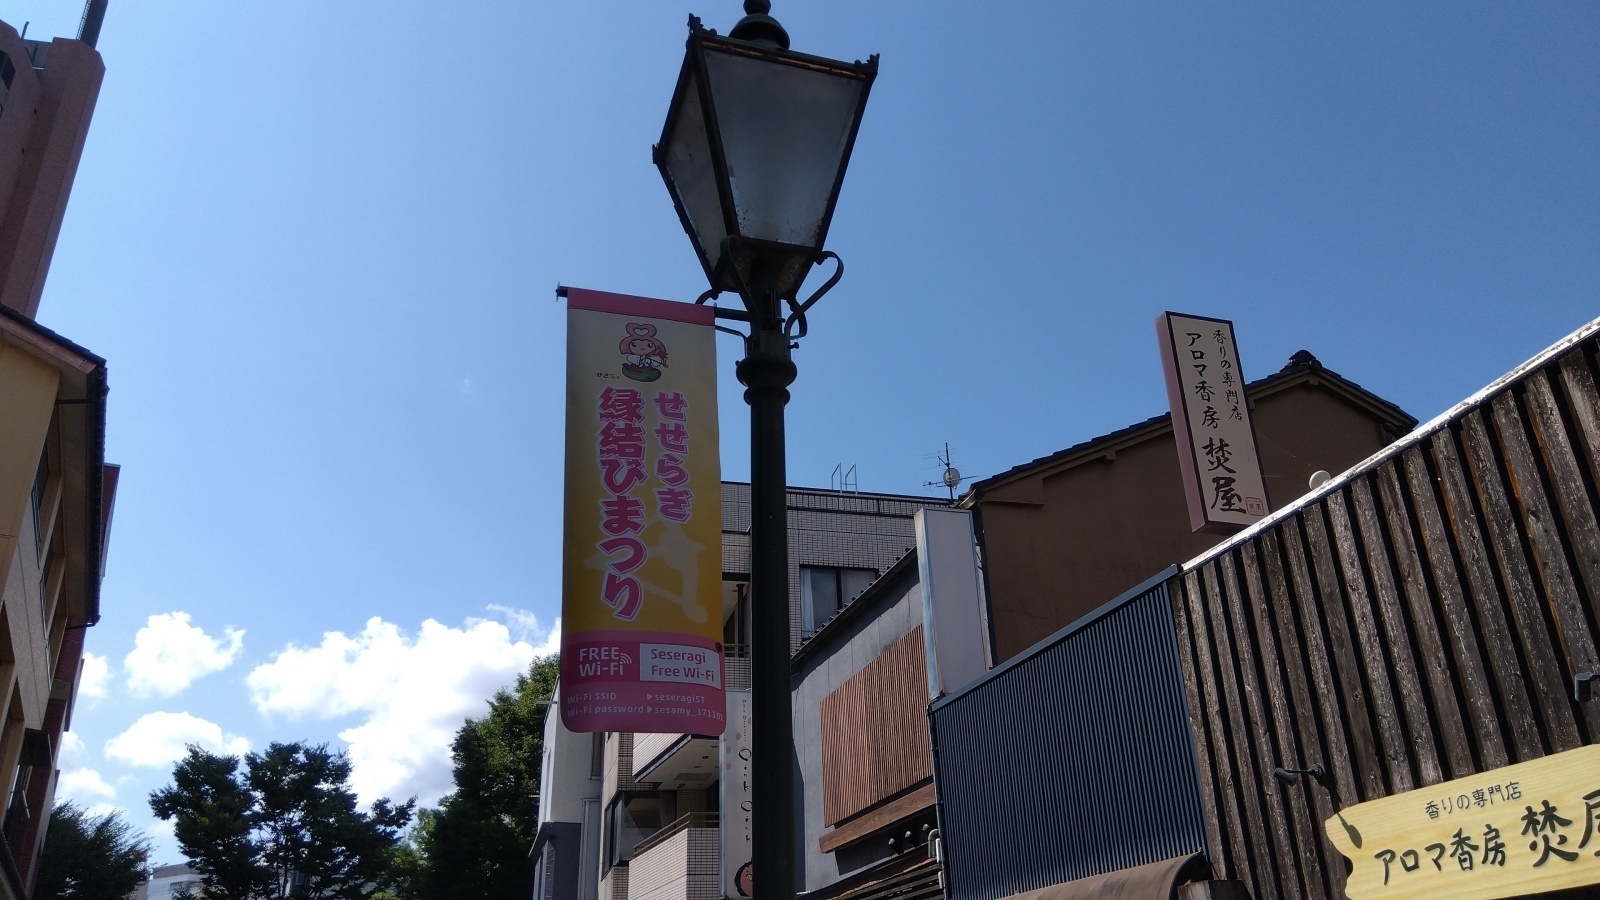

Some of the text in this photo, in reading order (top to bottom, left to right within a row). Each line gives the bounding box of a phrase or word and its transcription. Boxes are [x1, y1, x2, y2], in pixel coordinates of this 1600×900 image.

[1212, 329, 1243, 421] 香りの専門店
[1186, 332, 1247, 514] アロマ香房 焚屋
[653, 391, 693, 523] せせらぎ
[598, 386, 647, 620] 縁結びまつり
[579, 647, 620, 661] FREE
[651, 649, 706, 664] Seseragi
[579, 661, 624, 677] Wi-Fi
[651, 665, 715, 682] Free Wi-Fi
[567, 692, 705, 704] Wi-Fi SSID seseragiST
[567, 705, 592, 718] Wi-Fi
[594, 705, 644, 714] password
[1425, 781, 1522, 819] 香りの専門店
[1374, 823, 1507, 886] アロマ香房
